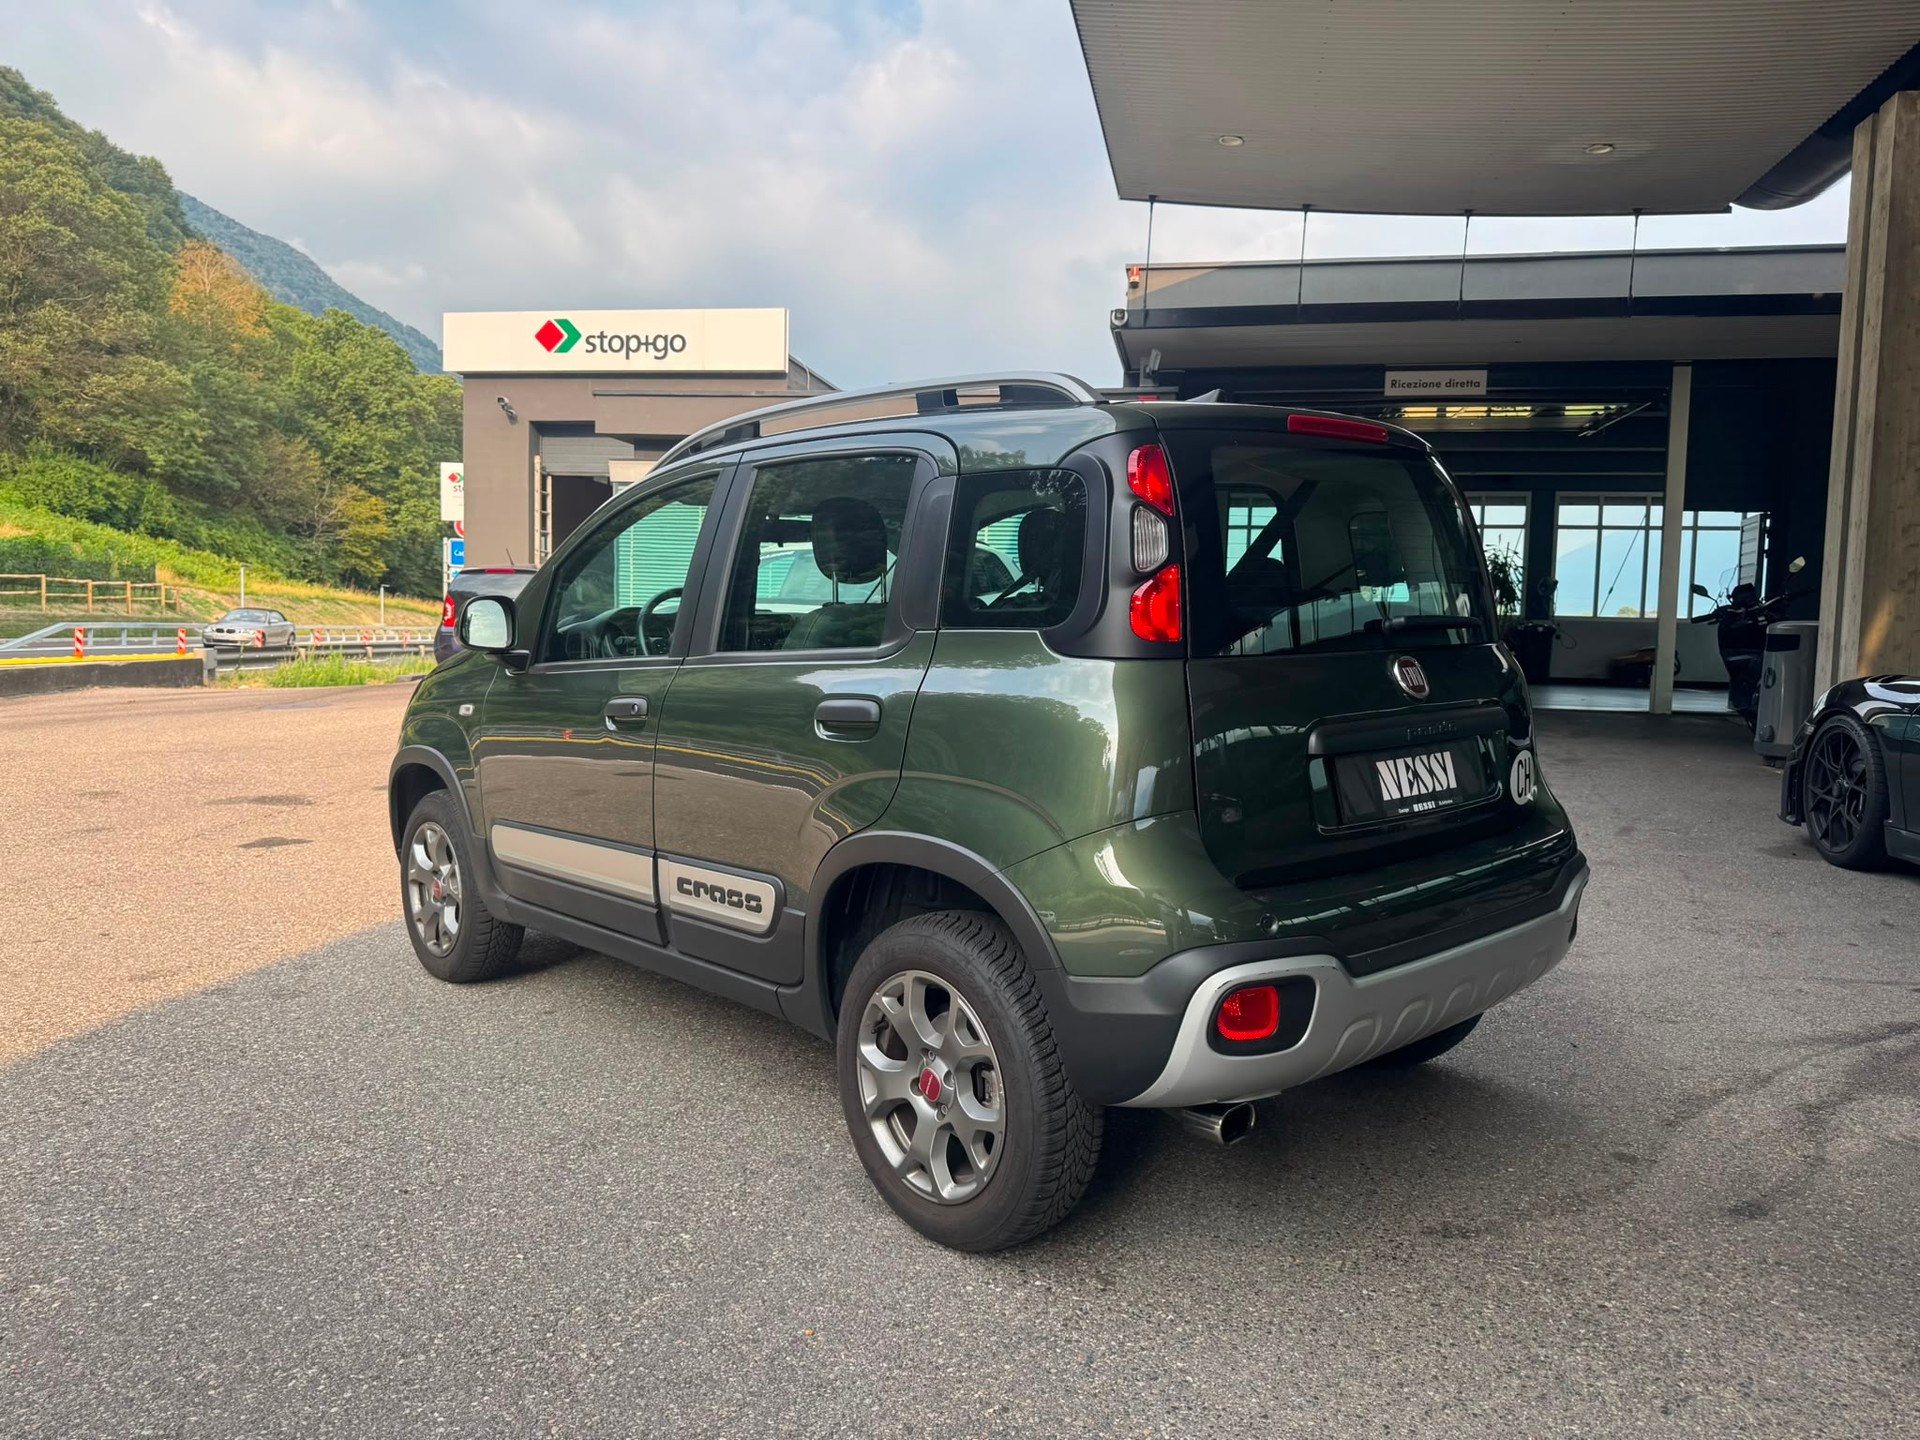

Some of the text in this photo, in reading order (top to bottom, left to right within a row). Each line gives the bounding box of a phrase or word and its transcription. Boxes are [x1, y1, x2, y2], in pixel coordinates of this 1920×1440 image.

[585, 331, 687, 360] stop+go
[1390, 378, 1481, 389] Ricezione diretta
[1375, 751, 1458, 801] NESSI
[1517, 757, 1531, 798] CH
